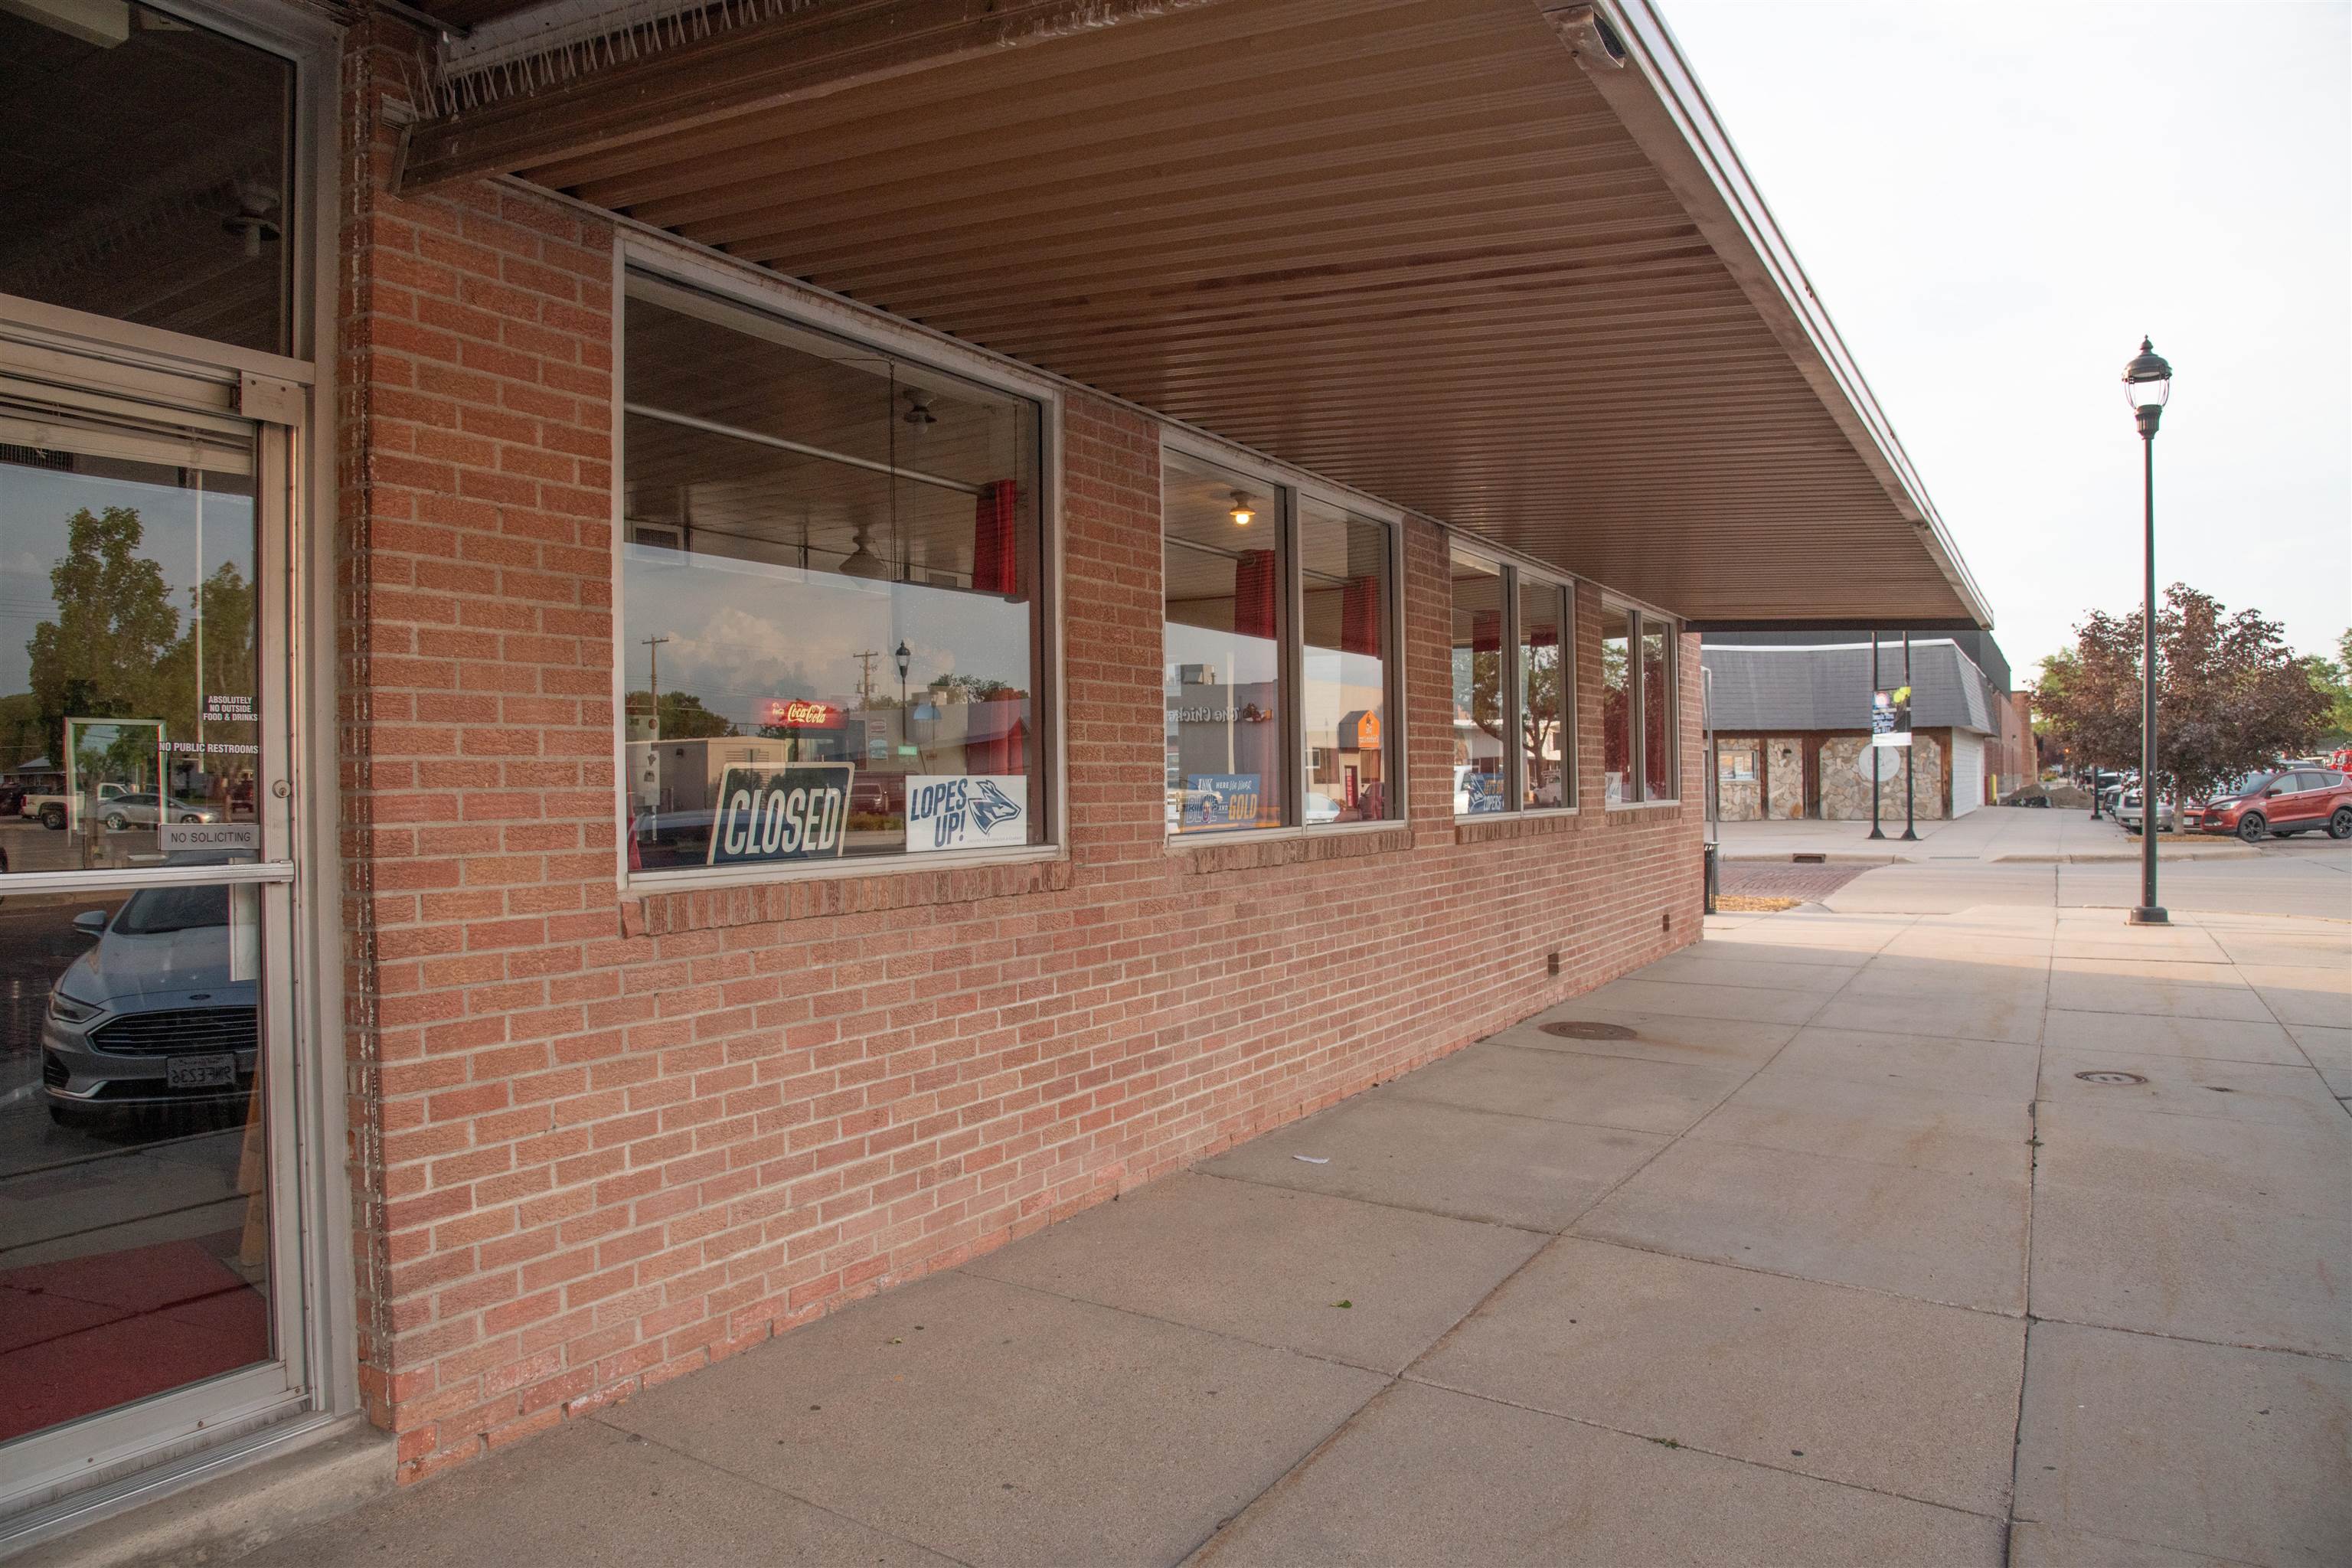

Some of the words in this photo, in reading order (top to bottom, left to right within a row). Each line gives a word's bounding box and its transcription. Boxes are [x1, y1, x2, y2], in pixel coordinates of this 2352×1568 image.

[208, 696, 253, 704] ABSOLUTELY
[209, 704, 220, 713] NO
[221, 704, 252, 713] OUTSIDE
[158, 742, 172, 751] NO
[173, 743, 206, 753] PUBLIC
[207, 743, 259, 754] RESTROOMS
[910, 778, 969, 822] LOPES
[1228, 793, 1258, 822] GOLD
[724, 787, 841, 855] CLOSED
[934, 810, 966, 848] UP!
[171, 832, 187, 842] NO
[190, 831, 251, 842] SOLICITING
